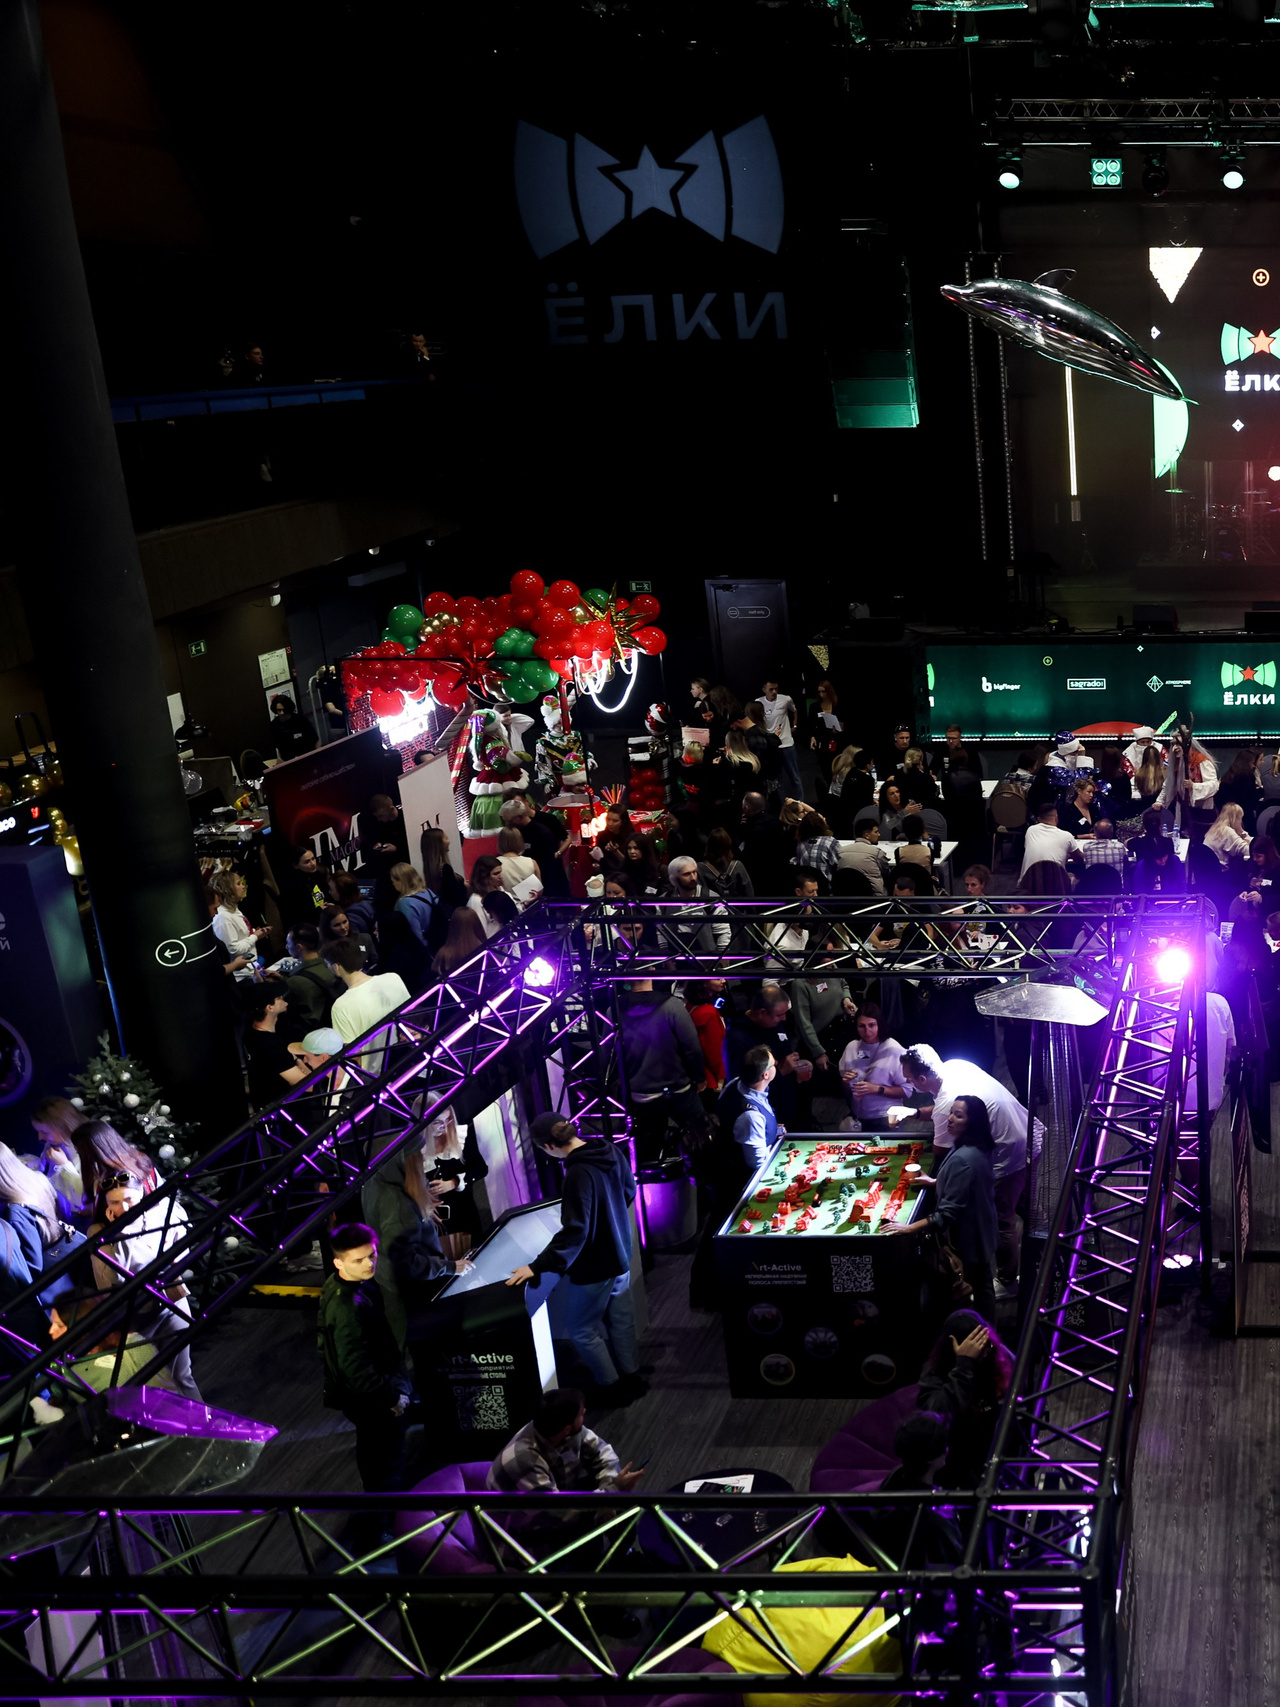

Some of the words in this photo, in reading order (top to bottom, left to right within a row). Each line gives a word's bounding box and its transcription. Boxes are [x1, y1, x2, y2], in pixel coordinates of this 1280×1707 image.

[544, 280, 789, 345] ЁЛКИ
[1223, 692, 1276, 706] ЁЛКИ
[329, 838, 360, 864] MAGIC
